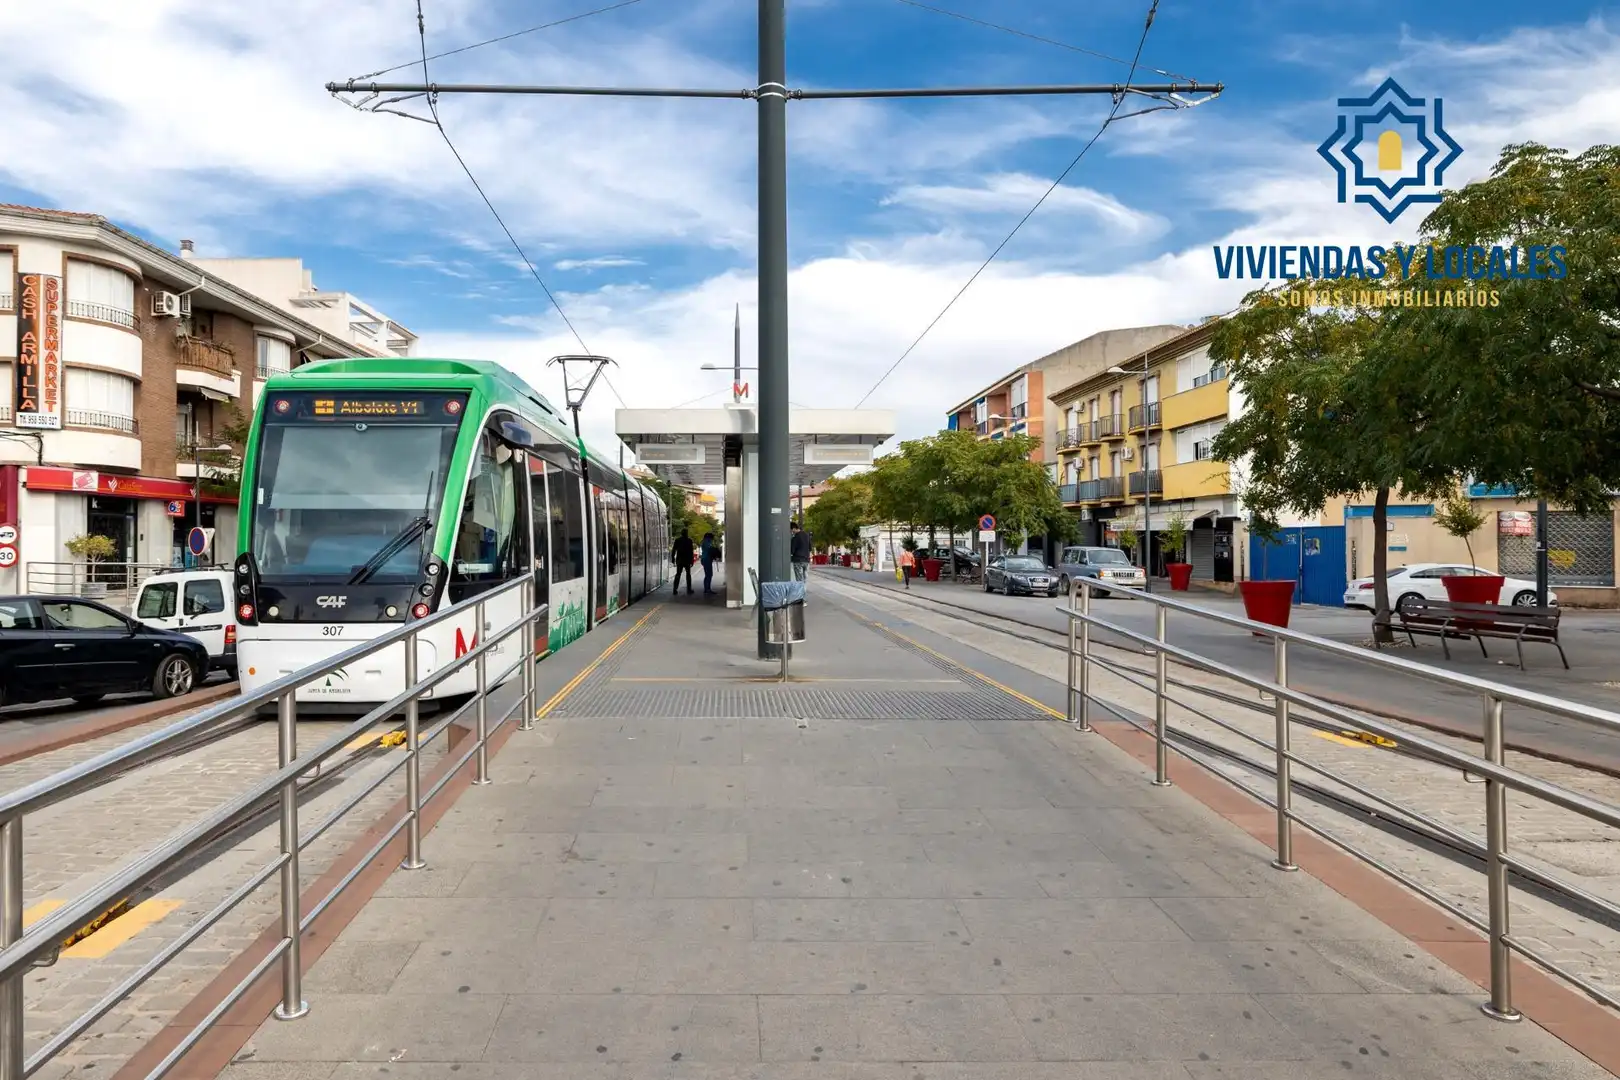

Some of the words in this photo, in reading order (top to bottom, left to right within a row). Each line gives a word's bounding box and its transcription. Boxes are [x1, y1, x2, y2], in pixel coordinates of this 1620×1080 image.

[22, 275, 38, 319] CASH
[45, 278, 59, 413] SUPERMARKET
[20, 331, 37, 411] ARMILLA
[733, 382, 749, 398] M
[0, 551, 14, 561] 30
[316, 595, 348, 608] CAF
[322, 625, 344, 636] 307
